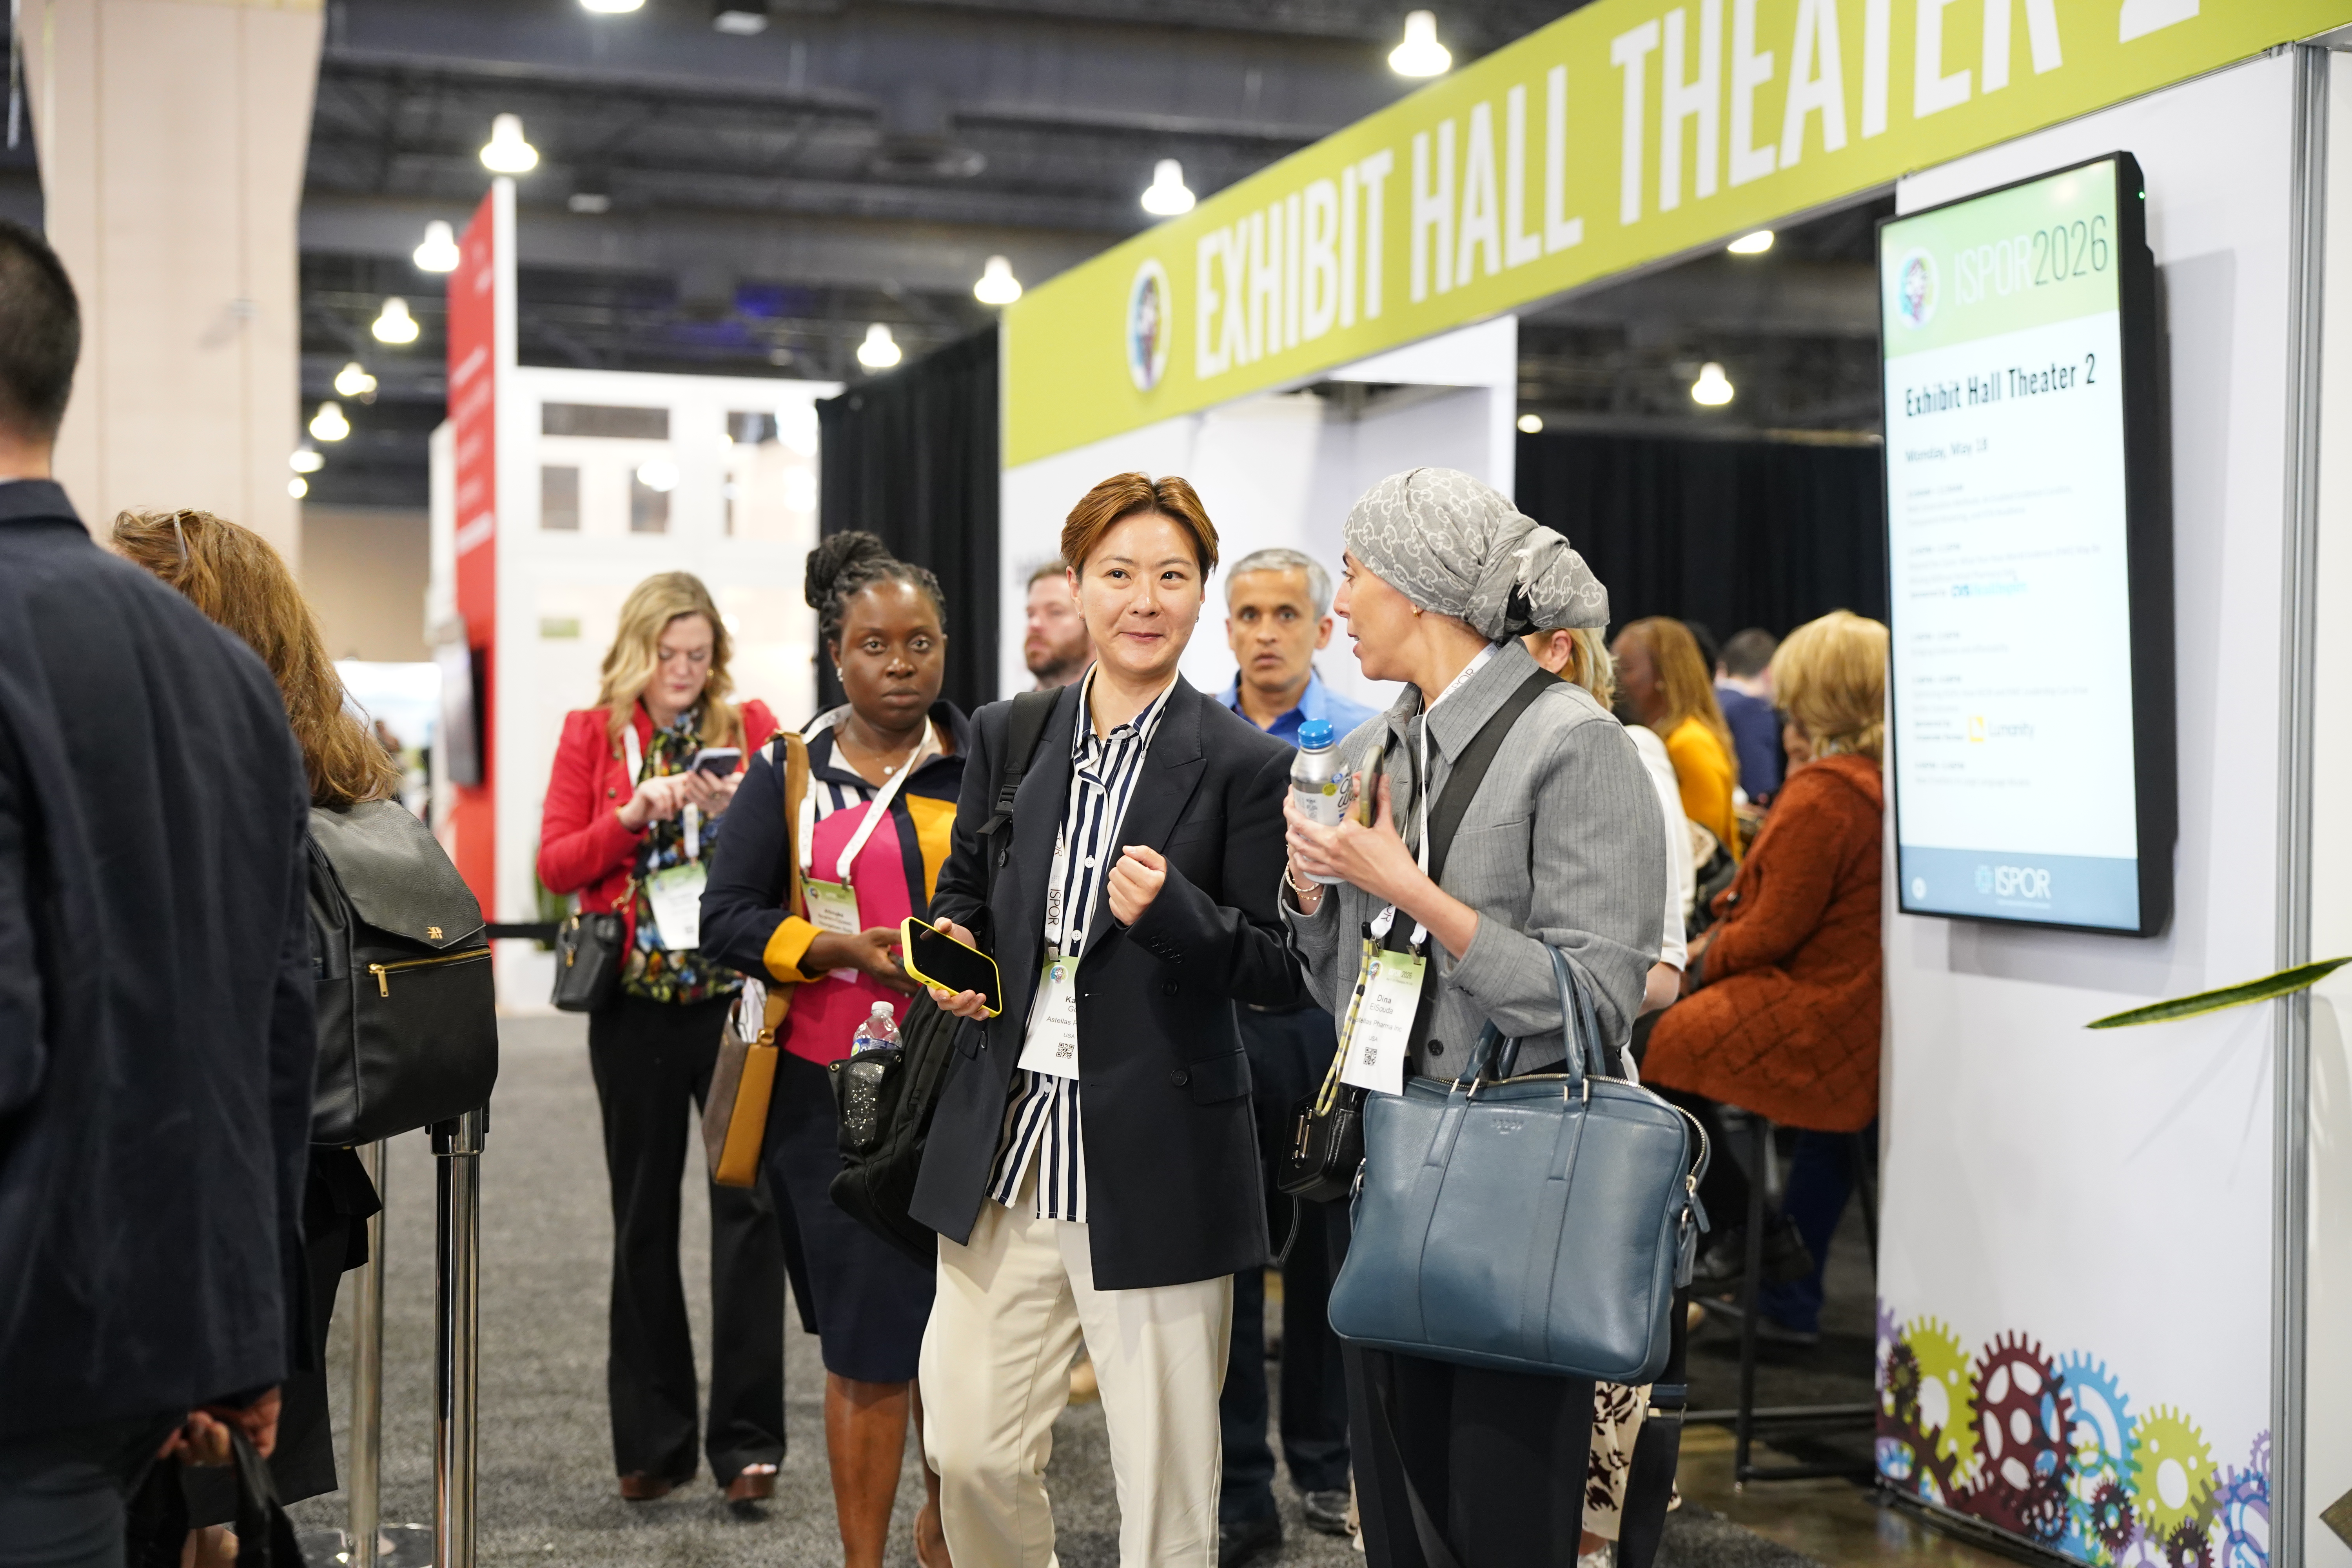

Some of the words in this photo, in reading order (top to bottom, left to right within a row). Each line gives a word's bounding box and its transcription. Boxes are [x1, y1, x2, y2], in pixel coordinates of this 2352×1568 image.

[1196, 148, 1394, 381] EXHIBIT
[1410, 64, 1584, 304] HALL
[1906, 380, 1961, 417] Exhibit
[1968, 371, 2001, 407] Hall
[2008, 363, 2077, 398] Theater
[2085, 353, 2096, 385] 2
[1444, 668, 1475, 695] ISPOR
[1054, 822, 1063, 857] POR
[1995, 865, 2052, 900] ISPOR
[1047, 889, 1061, 925] ISPOR
[1377, 994, 1392, 1004] Dina
[1046, 1016, 1071, 1025] Astellas
[1355, 1017, 1372, 1025] stellas
[1373, 1020, 1393, 1030] Pharma
